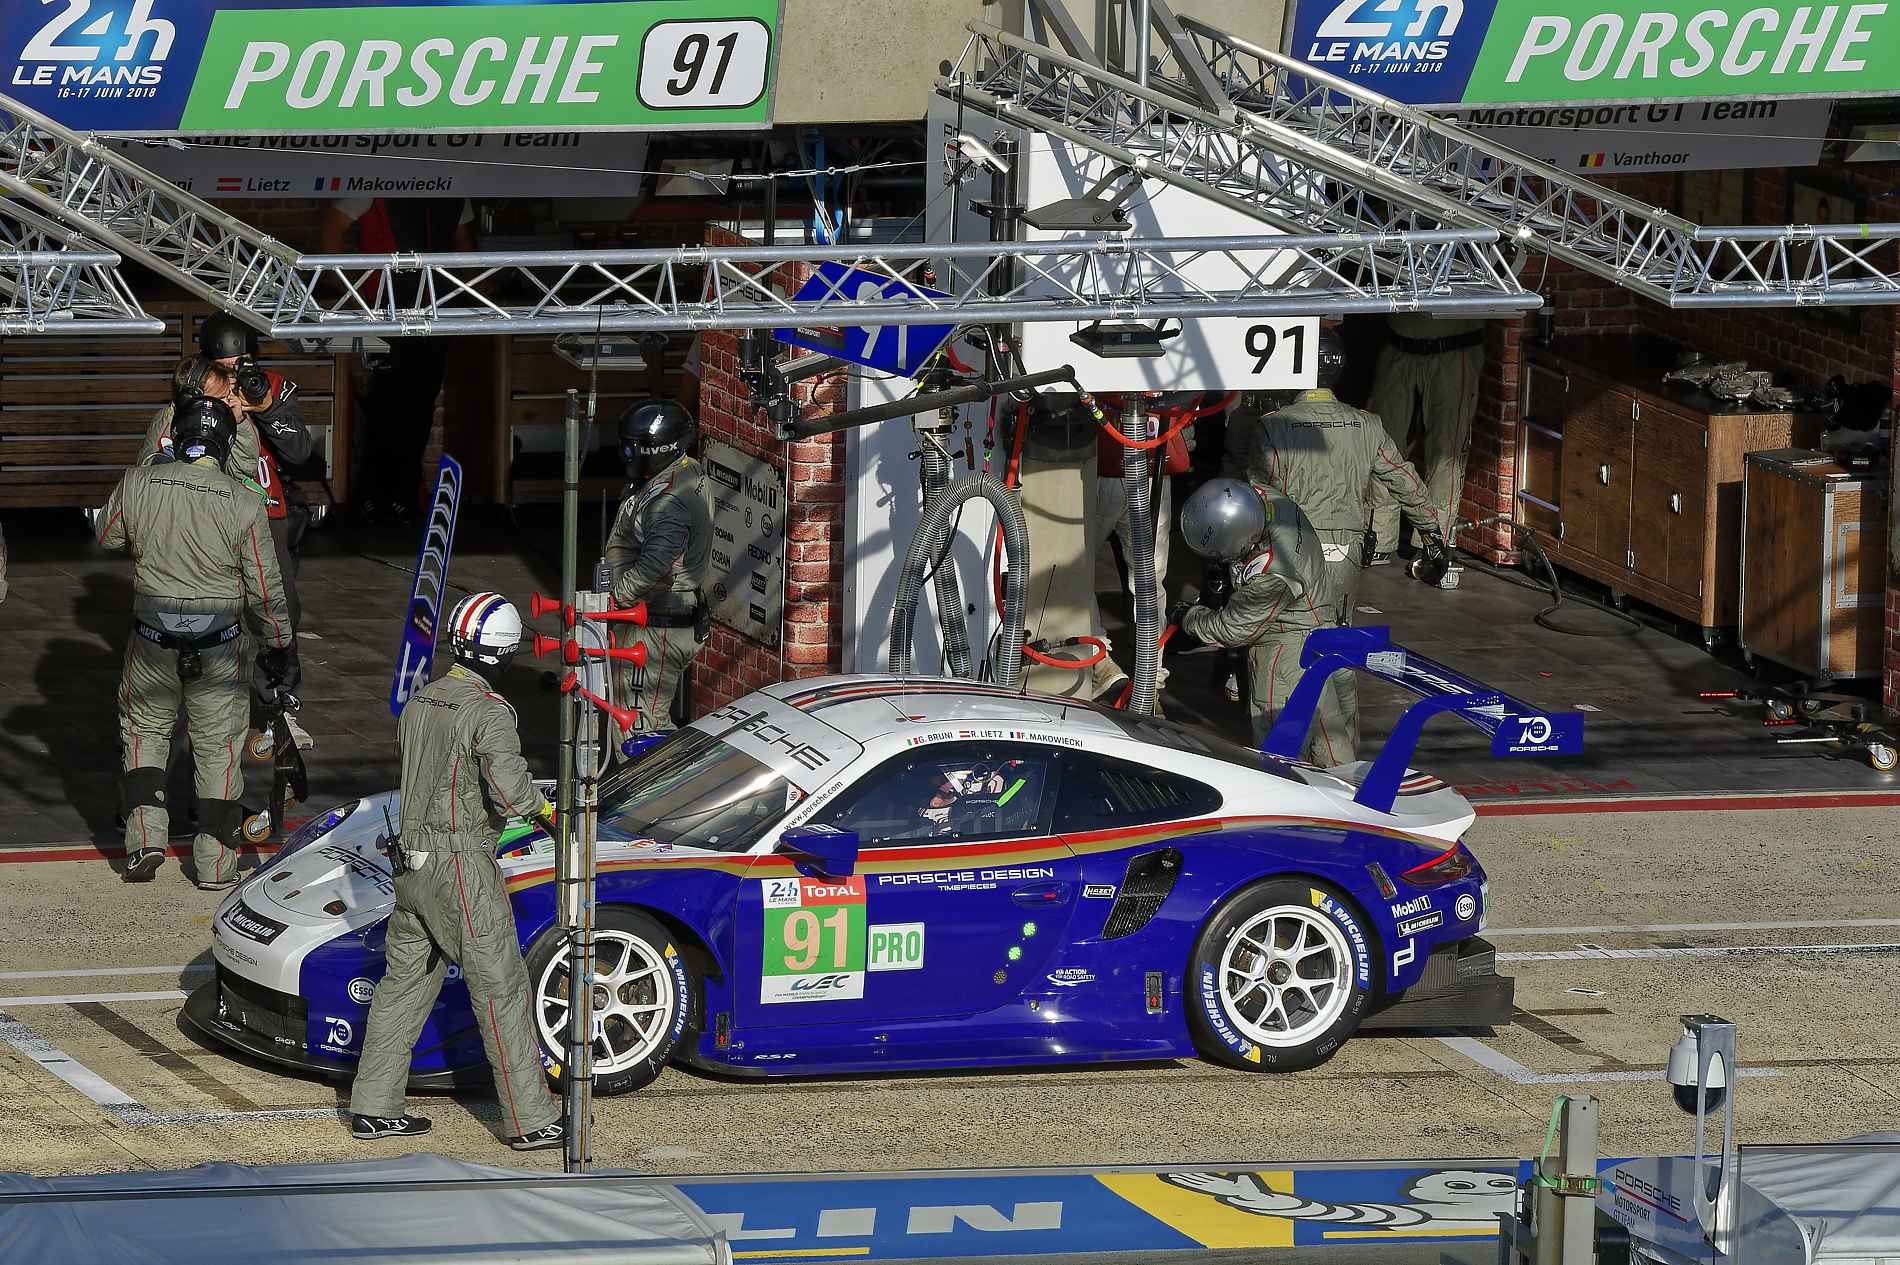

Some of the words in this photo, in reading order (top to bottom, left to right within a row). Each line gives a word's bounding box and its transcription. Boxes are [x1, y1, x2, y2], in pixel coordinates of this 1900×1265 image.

[20, 0, 176, 61] 24h
[1307, 43, 1351, 62] LE
[1352, 41, 1450, 61] MANS
[1504, 4, 1889, 83] PORSCHE
[223, 34, 620, 109] PORSCHE
[666, 32, 740, 96] 91
[1349, 64, 1380, 74] 16-17
[1383, 63, 1409, 73] JUIN
[1414, 62, 1443, 73] 2018
[11, 65, 57, 86] LE
[59, 65, 164, 86] MANS
[57, 87, 90, 99] 16-17
[93, 88, 122, 99] JUIN
[128, 87, 157, 98] 2018
[1468, 104, 1639, 131] Motorsport
[1613, 151, 1690, 167] Vanthoor
[246, 177, 291, 192] Lietz
[346, 176, 453, 192] Makowiecki
[1244, 324, 1305, 375] 91
[1290, 420, 1362, 429] PORSCHE
[640, 441, 679, 455] uvex
[149, 478, 232, 499] PORSCHE
[407, 695, 461, 712] PORSCHE
[928, 731, 954, 743] BRUNI
[980, 730, 1004, 738] LIETZ
[1029, 732, 1084, 748] MAKOWIECKI
[1518, 716, 1553, 744] 70
[783, 781, 844, 831] www.porsche.com
[878, 870, 976, 886] PORSCHE
[980, 867, 1055, 880] DESIGN
[937, 882, 997, 892] TIMEPIECES
[769, 881, 799, 898] 24h
[802, 885, 861, 898] TOTAL
[1086, 886, 1114, 896] HAZET
[1391, 899, 1421, 919] Mobil
[233, 913, 276, 937] MICHELIN
[1410, 915, 1439, 929] MICHELIN
[783, 907, 849, 972] 91
[871, 930, 922, 964] PRO
[1333, 906, 1369, 982] MICHELIN
[675, 967, 690, 1035] MICHELIN
[1202, 970, 1240, 1046] MICHELIN
[325, 1016, 353, 1046] 70
[1615, 1167, 1681, 1211] PORSCHE
[1614, 1194, 1651, 1221] MOTORSPORT
